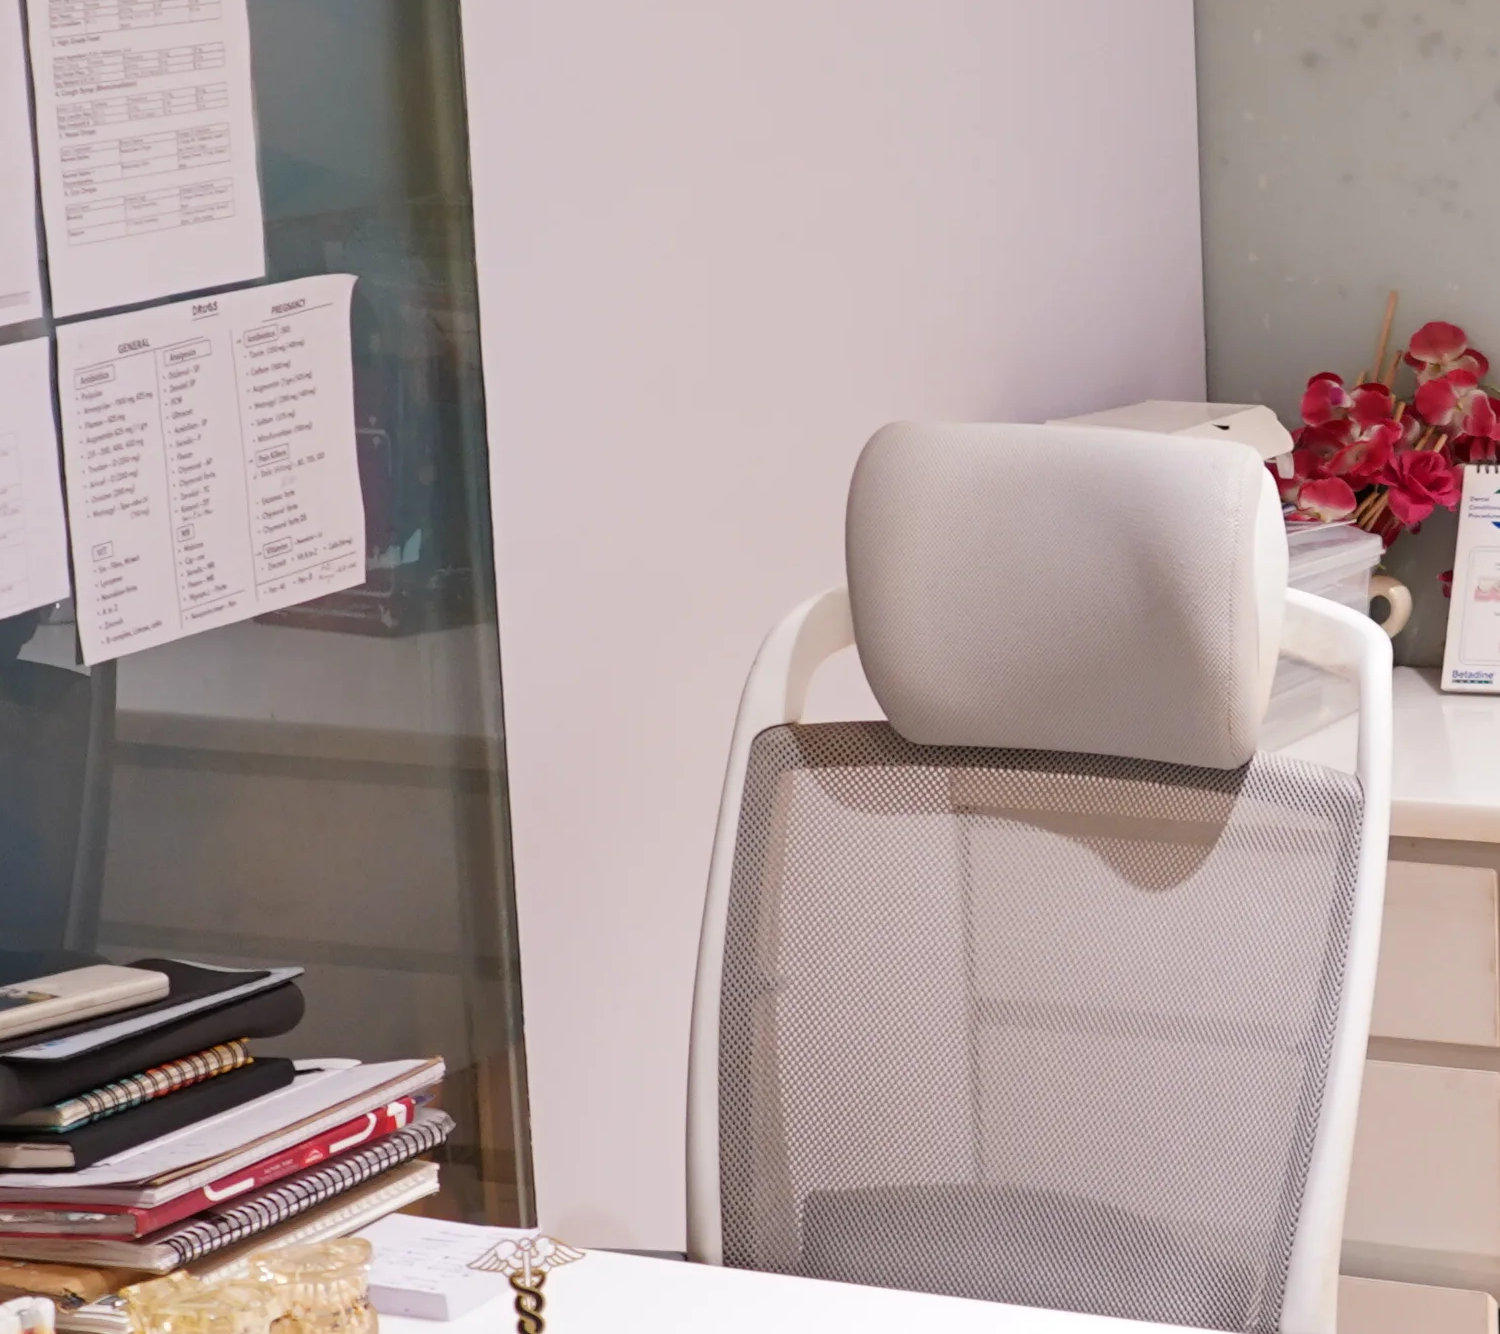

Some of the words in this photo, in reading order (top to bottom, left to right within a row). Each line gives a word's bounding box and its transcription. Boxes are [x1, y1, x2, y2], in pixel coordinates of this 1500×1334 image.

[192, 301, 218, 316] DRUGS
[271, 299, 306, 314] PREGNANCY
[118, 338, 150, 354] GENERAL
[1452, 670, 1494, 679] Betadine
